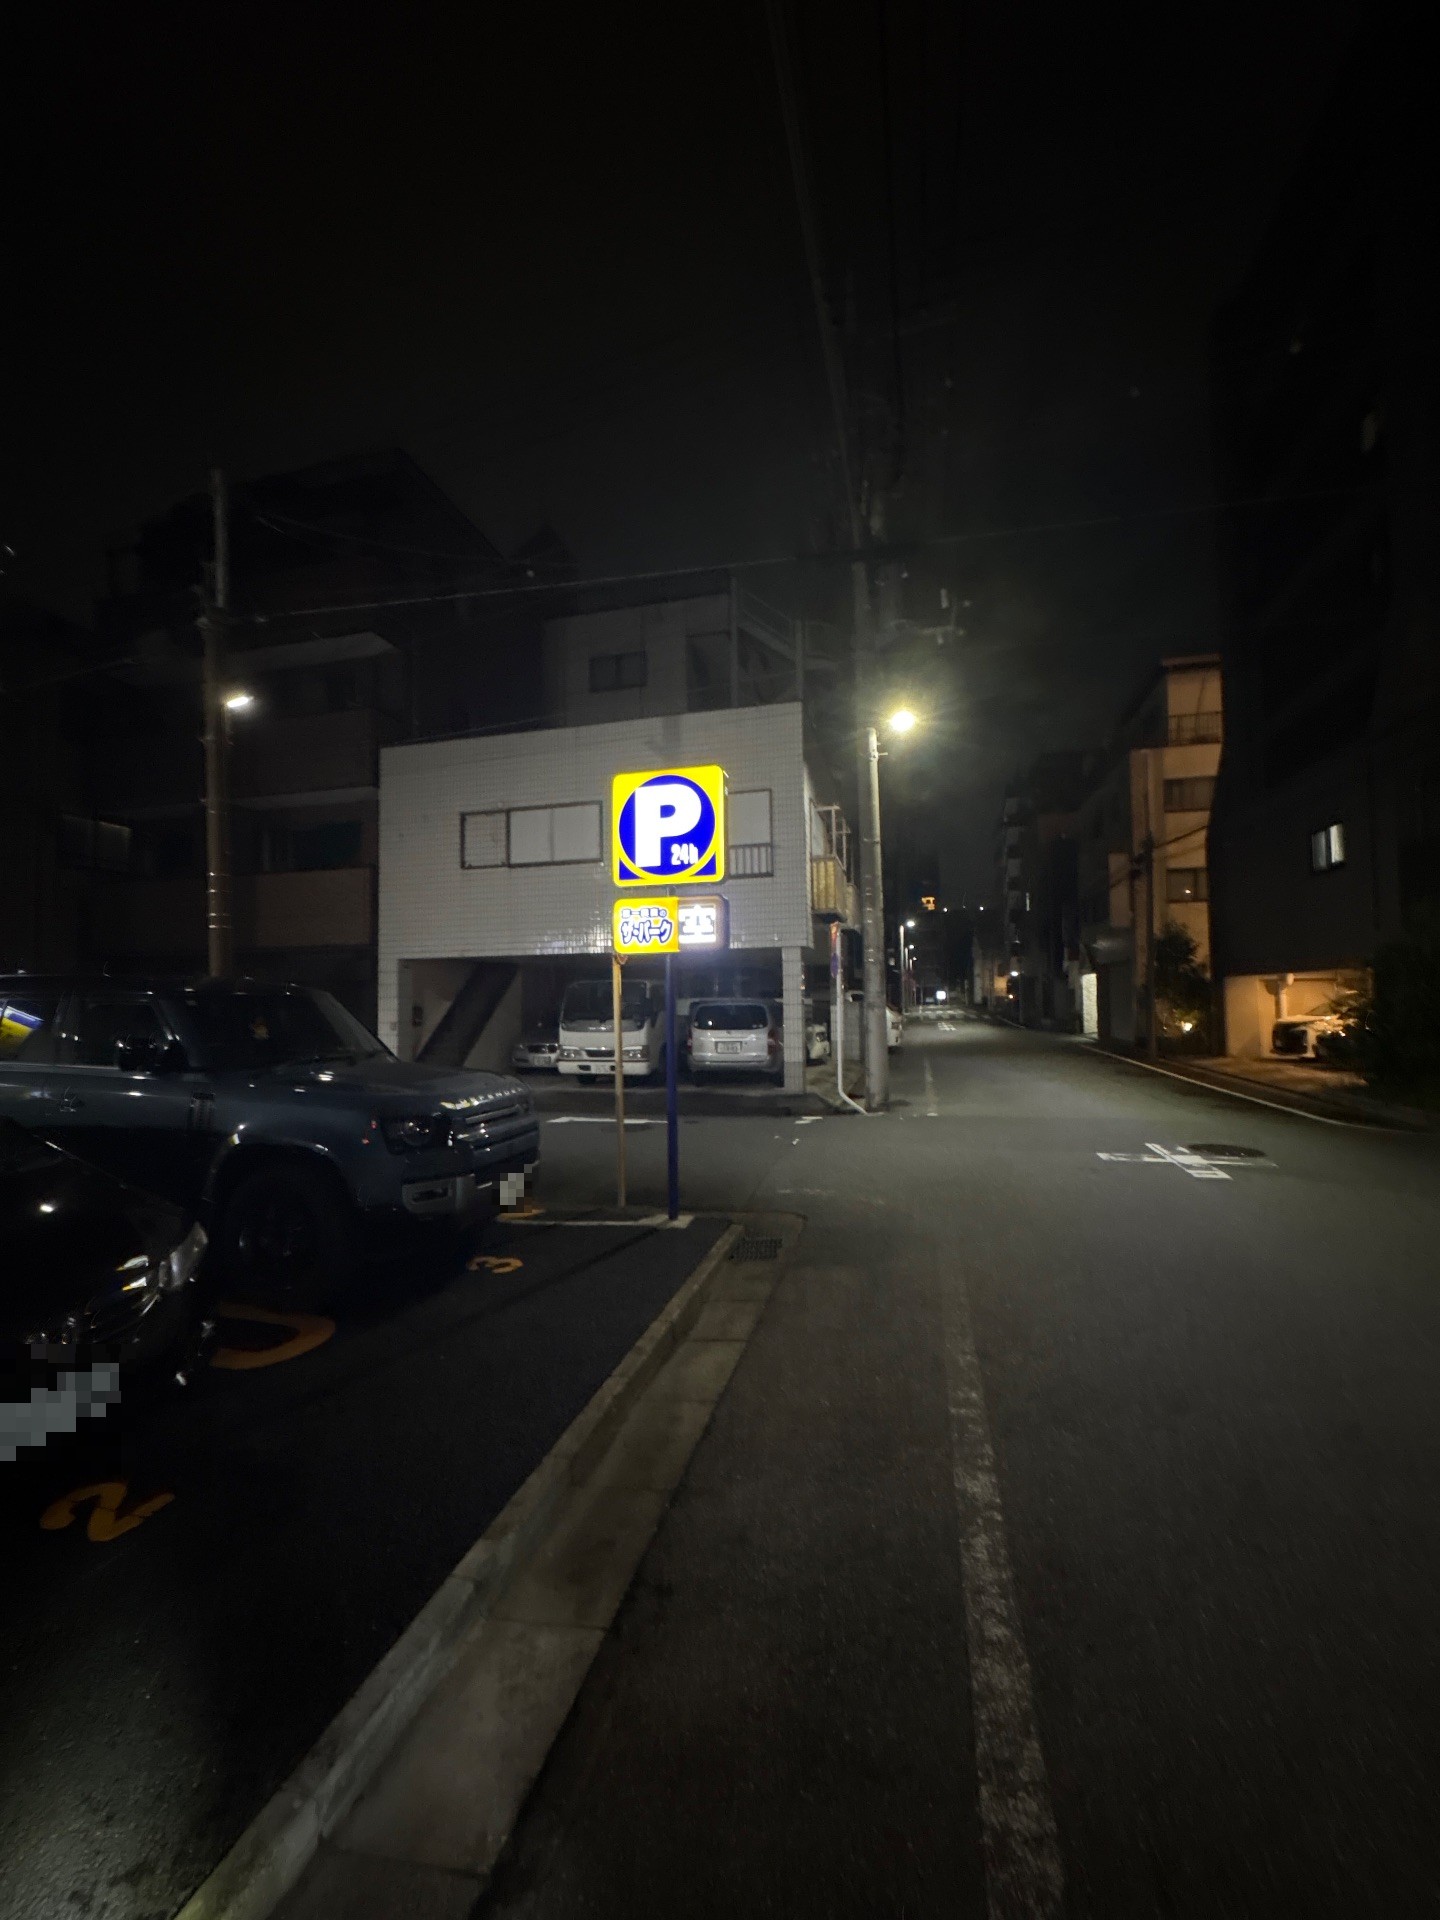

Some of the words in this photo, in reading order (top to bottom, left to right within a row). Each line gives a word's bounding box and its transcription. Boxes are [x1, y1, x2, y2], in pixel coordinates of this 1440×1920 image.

[635, 784, 702, 867] P
[671, 843, 698, 865] 24h
[40, 1481, 176, 1542] 2
